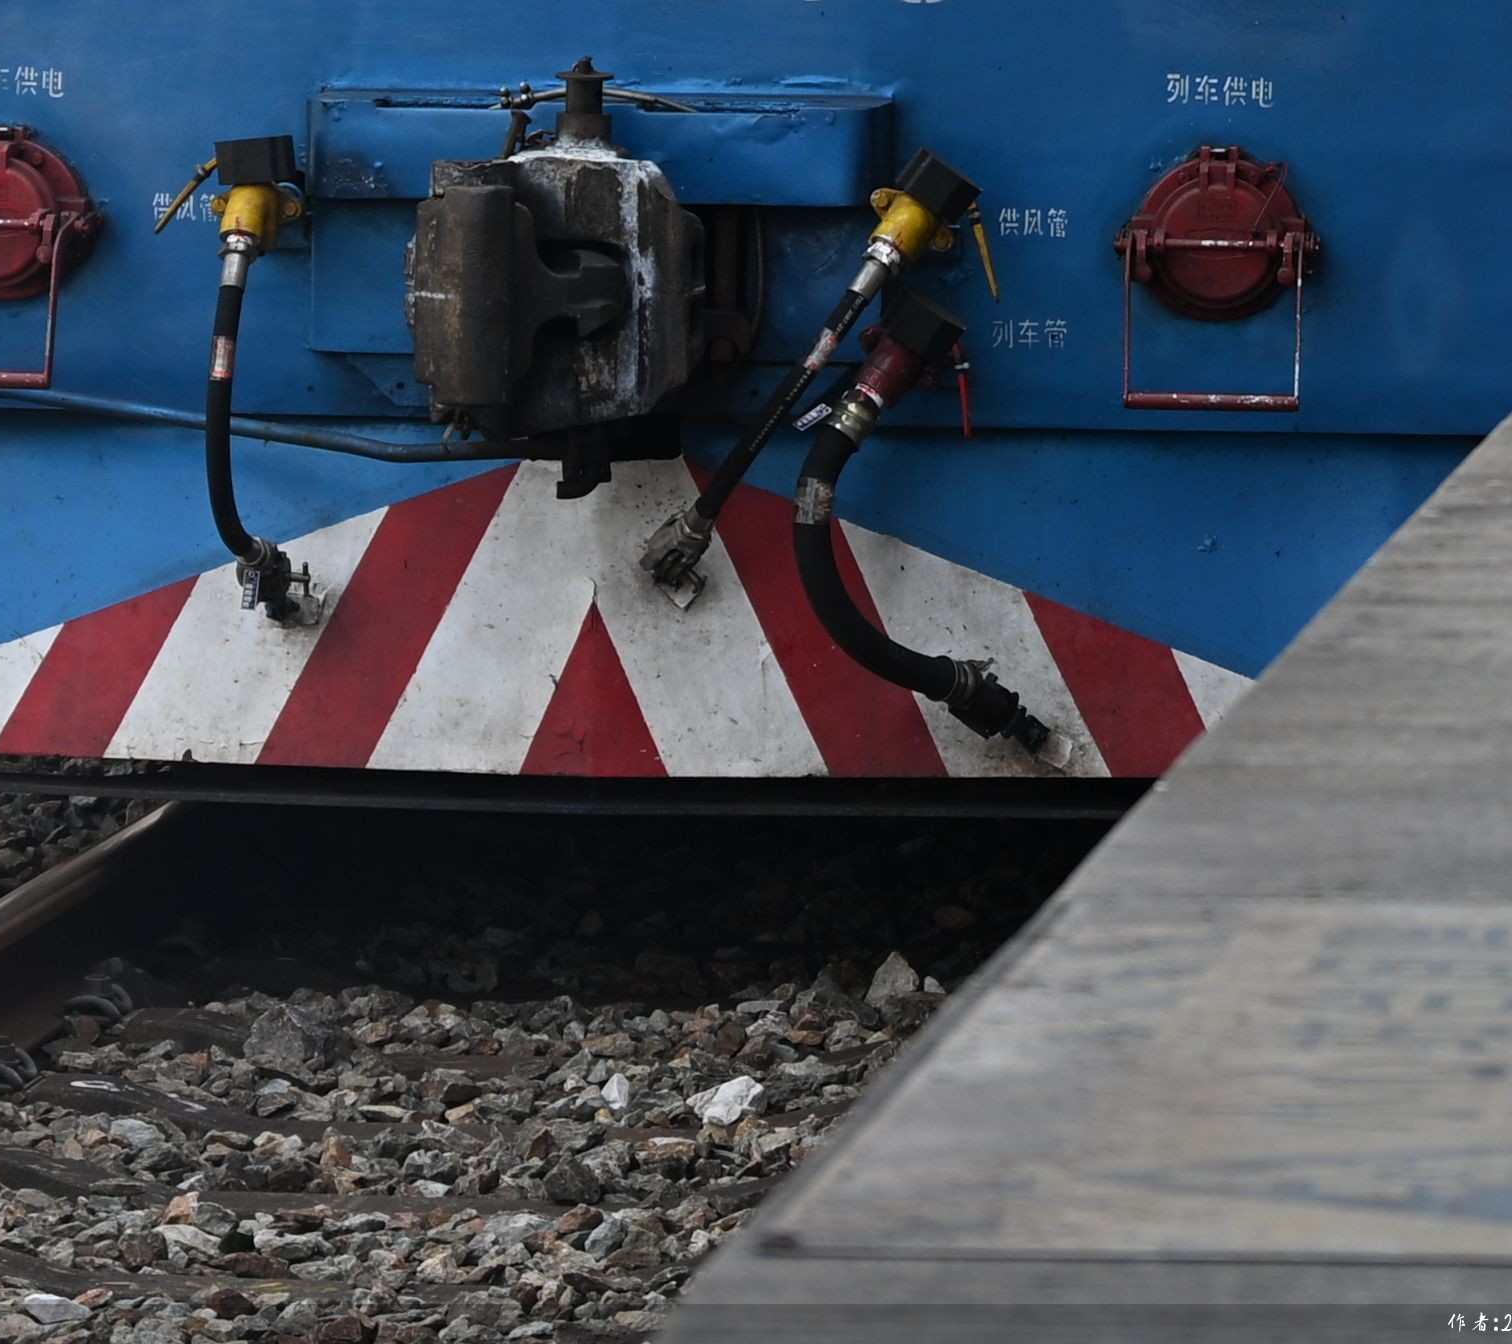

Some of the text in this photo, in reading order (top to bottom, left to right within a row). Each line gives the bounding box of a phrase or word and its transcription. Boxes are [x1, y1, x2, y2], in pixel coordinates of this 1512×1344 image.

[1166, 73, 1275, 109] 列车供电
[999, 207, 1068, 238] 供风管
[992, 318, 1068, 349] 列车管
